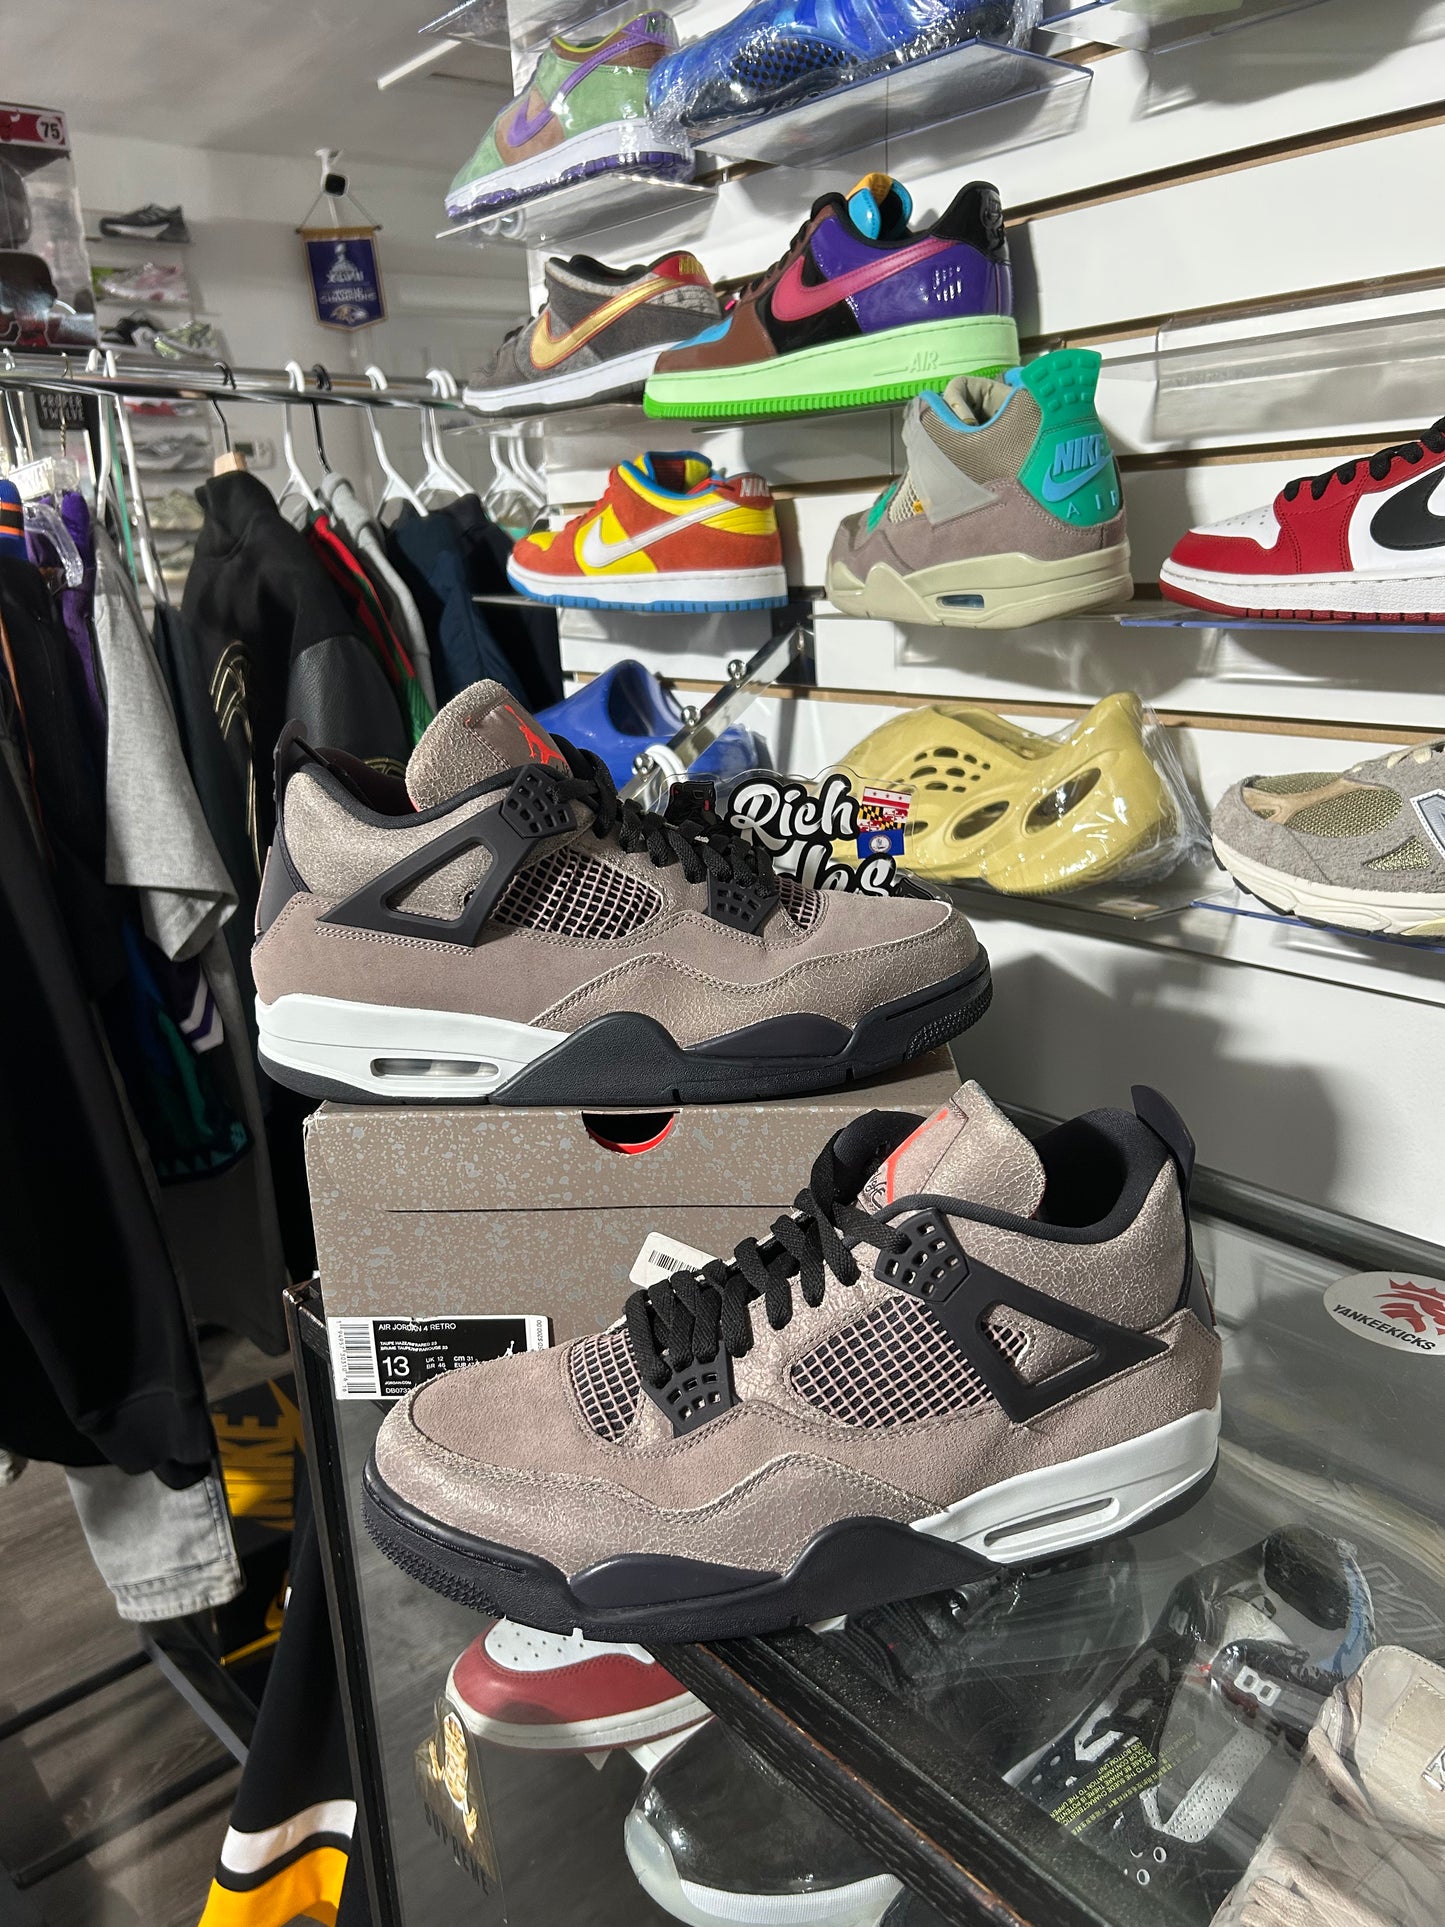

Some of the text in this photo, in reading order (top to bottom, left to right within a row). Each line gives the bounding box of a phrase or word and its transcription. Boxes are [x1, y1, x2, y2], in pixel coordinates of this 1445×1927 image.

[40, 121, 60, 140] 75
[910, 351, 939, 373] AIR
[41, 407, 84, 421] TWLVE
[1053, 433, 1104, 477] NIKE
[730, 780, 853, 850] Rich
[378, 1323, 391, 1331] AIR
[392, 1323, 422, 1332] JORDAN
[430, 1322, 457, 1330] RETRO
[1332, 1304, 1436, 1350] YANKEEKICKS
[382, 1356, 410, 1377] 13
[210, 1413, 295, 1516] NIKE
[1130, 1739, 1142, 1750] AND
[1108, 1747, 1131, 1766] BOTTOM
[1127, 1745, 1147, 1761] COLOR
[1130, 1750, 1152, 1768] PLEASE
[1122, 1764, 1131, 1773] BE
[1135, 1764, 1144, 1773] TO
[1143, 1756, 1156, 1768] DUE
[1085, 1758, 1129, 1790] CONTAMINATION
[1103, 1769, 1124, 1786] AWARE
[1124, 1770, 1136, 1780] THE
[1077, 1787, 1086, 1796] TO
[1085, 1783, 1105, 1799] THERE
[1106, 1777, 1125, 1793] SUEDE
[1066, 1793, 1079, 1804] THE
[1079, 1795, 1087, 1803] IS
[1054, 1799, 1081, 1823] POTENTIA
